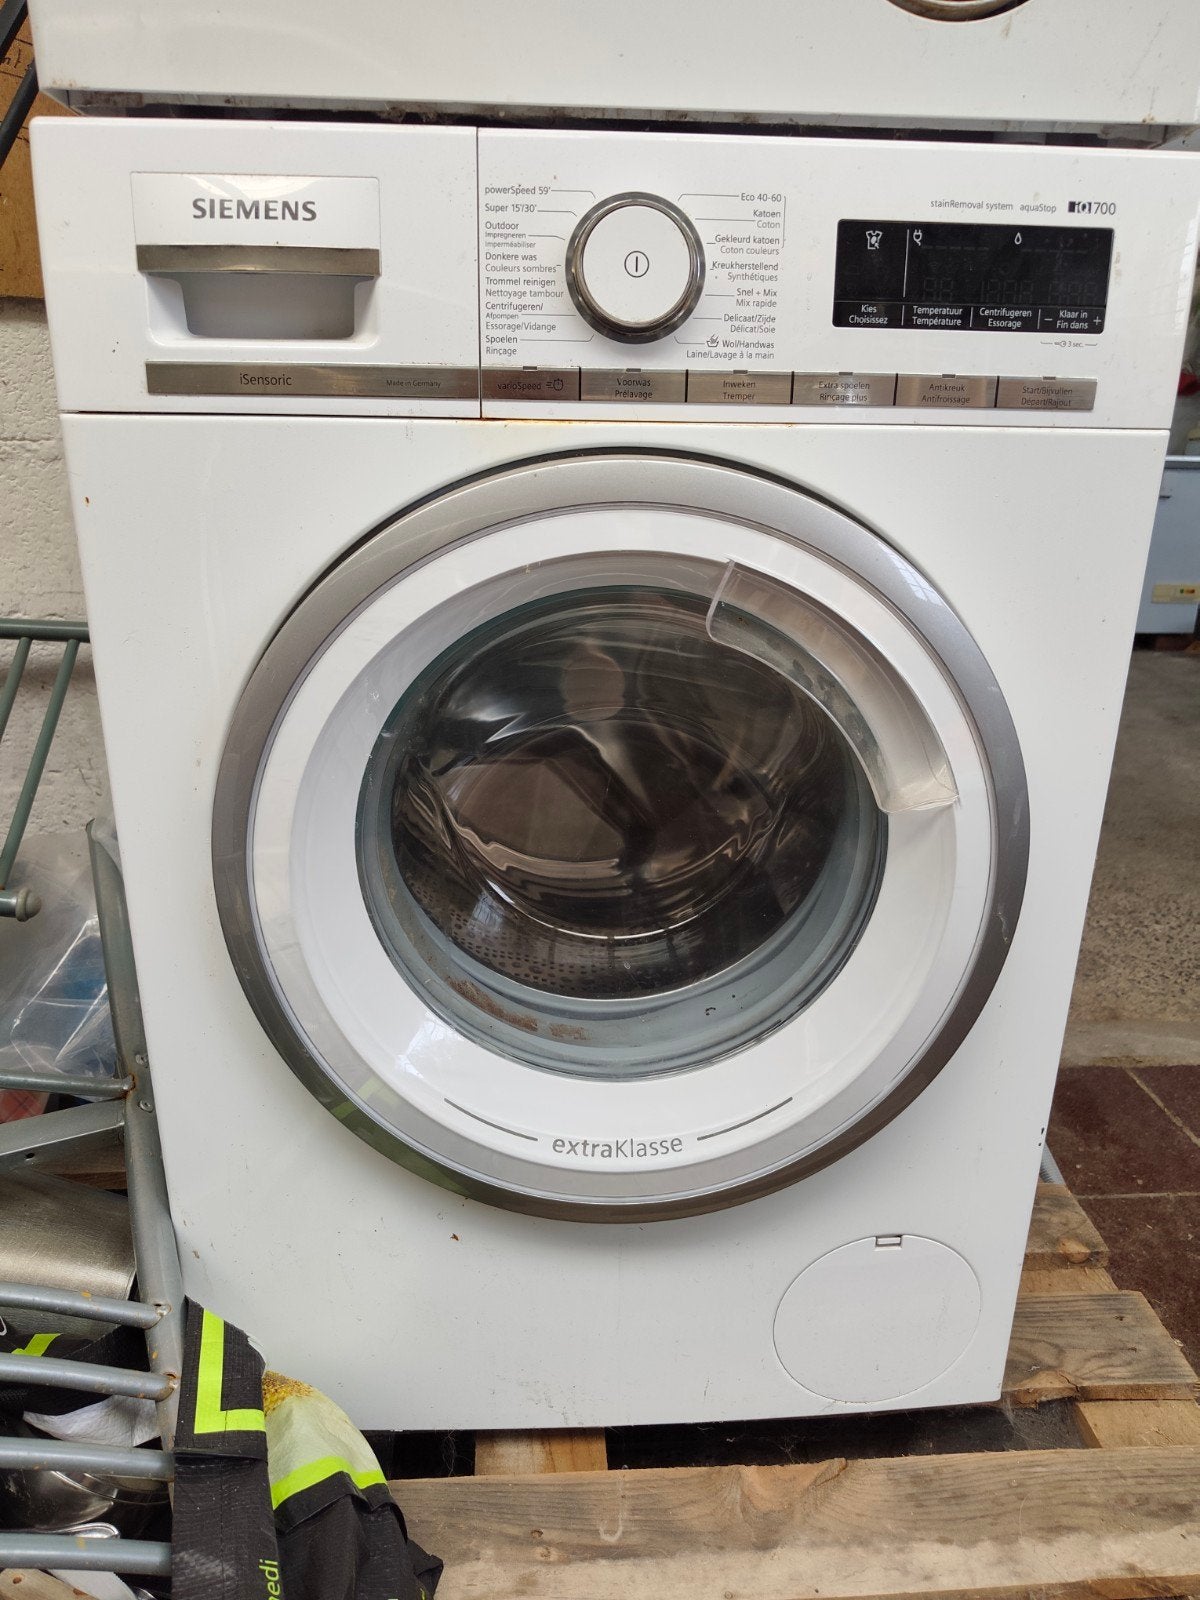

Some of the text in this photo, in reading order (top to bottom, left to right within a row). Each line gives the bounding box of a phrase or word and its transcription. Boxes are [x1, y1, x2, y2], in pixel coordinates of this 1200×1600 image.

[485, 186, 551, 195] powerSpeed 59'
[740, 193, 782, 202] Eco 40-60
[192, 197, 317, 221] SIEMENS
[485, 203, 508, 213] Super
[930, 199, 1014, 211] stainRemoval system
[1019, 202, 1057, 213] aquaStop
[753, 209, 780, 218] Katoen
[485, 221, 519, 230] Outdoor
[756, 220, 781, 229] Coton
[485, 231, 526, 239] Impregneren
[715, 234, 780, 245] Gekleurd katoen
[720, 245, 780, 255] Coton couleurs
[485, 252, 519, 260] Donkere
[485, 263, 557, 273] Couleurs sombres
[712, 261, 779, 270] Kreukherstellend
[727, 272, 778, 282] Synthétiques
[485, 277, 556, 288] Trommel reinigen
[485, 289, 564, 299] Nettoyage tambour
[736, 288, 754, 296] Snel
[763, 289, 777, 297] Mix
[485, 302, 543, 311] Centrifugeren/
[736, 299, 777, 309] Mix rapide
[861, 304, 877, 313] Kies
[912, 305, 963, 316] Temperatuur
[979, 307, 1032, 318] Centrifugeren
[1059, 310, 1088, 318] Klaar in
[486, 312, 519, 320] Afpompen
[723, 314, 776, 325] Delicaat/Zijde
[848, 314, 888, 325] Choisissez
[912, 316, 962, 326] Température
[486, 322, 556, 332] Essorage/Vidange
[730, 324, 776, 333] Délicat/Soie
[988, 318, 1022, 329] Essorage
[1056, 321, 1089, 329] Fin dans
[485, 335, 518, 344] Spoelen
[722, 340, 775, 349] Wol/Handwas
[486, 346, 517, 357] Rinçage
[686, 350, 737, 360] Laine/Lavage
[739, 351, 744, 359] à
[746, 351, 753, 359] la
[239, 373, 292, 386] iSensoric
[386, 379, 441, 388] Made in Germany
[617, 378, 651, 387] Voorwas
[723, 380, 756, 389] Inweken
[497, 381, 541, 391] varioSpeed
[819, 381, 870, 391] Extra spoelen
[929, 383, 965, 392] Antikreuk
[615, 389, 653, 400] Prélavage
[723, 392, 755, 401] Tremper
[819, 393, 868, 402] Rinçage plus
[922, 394, 971, 405] Antifroissage
[552, 1135, 683, 1159] extraKlasse
[259, 1559, 280, 1600] edi
